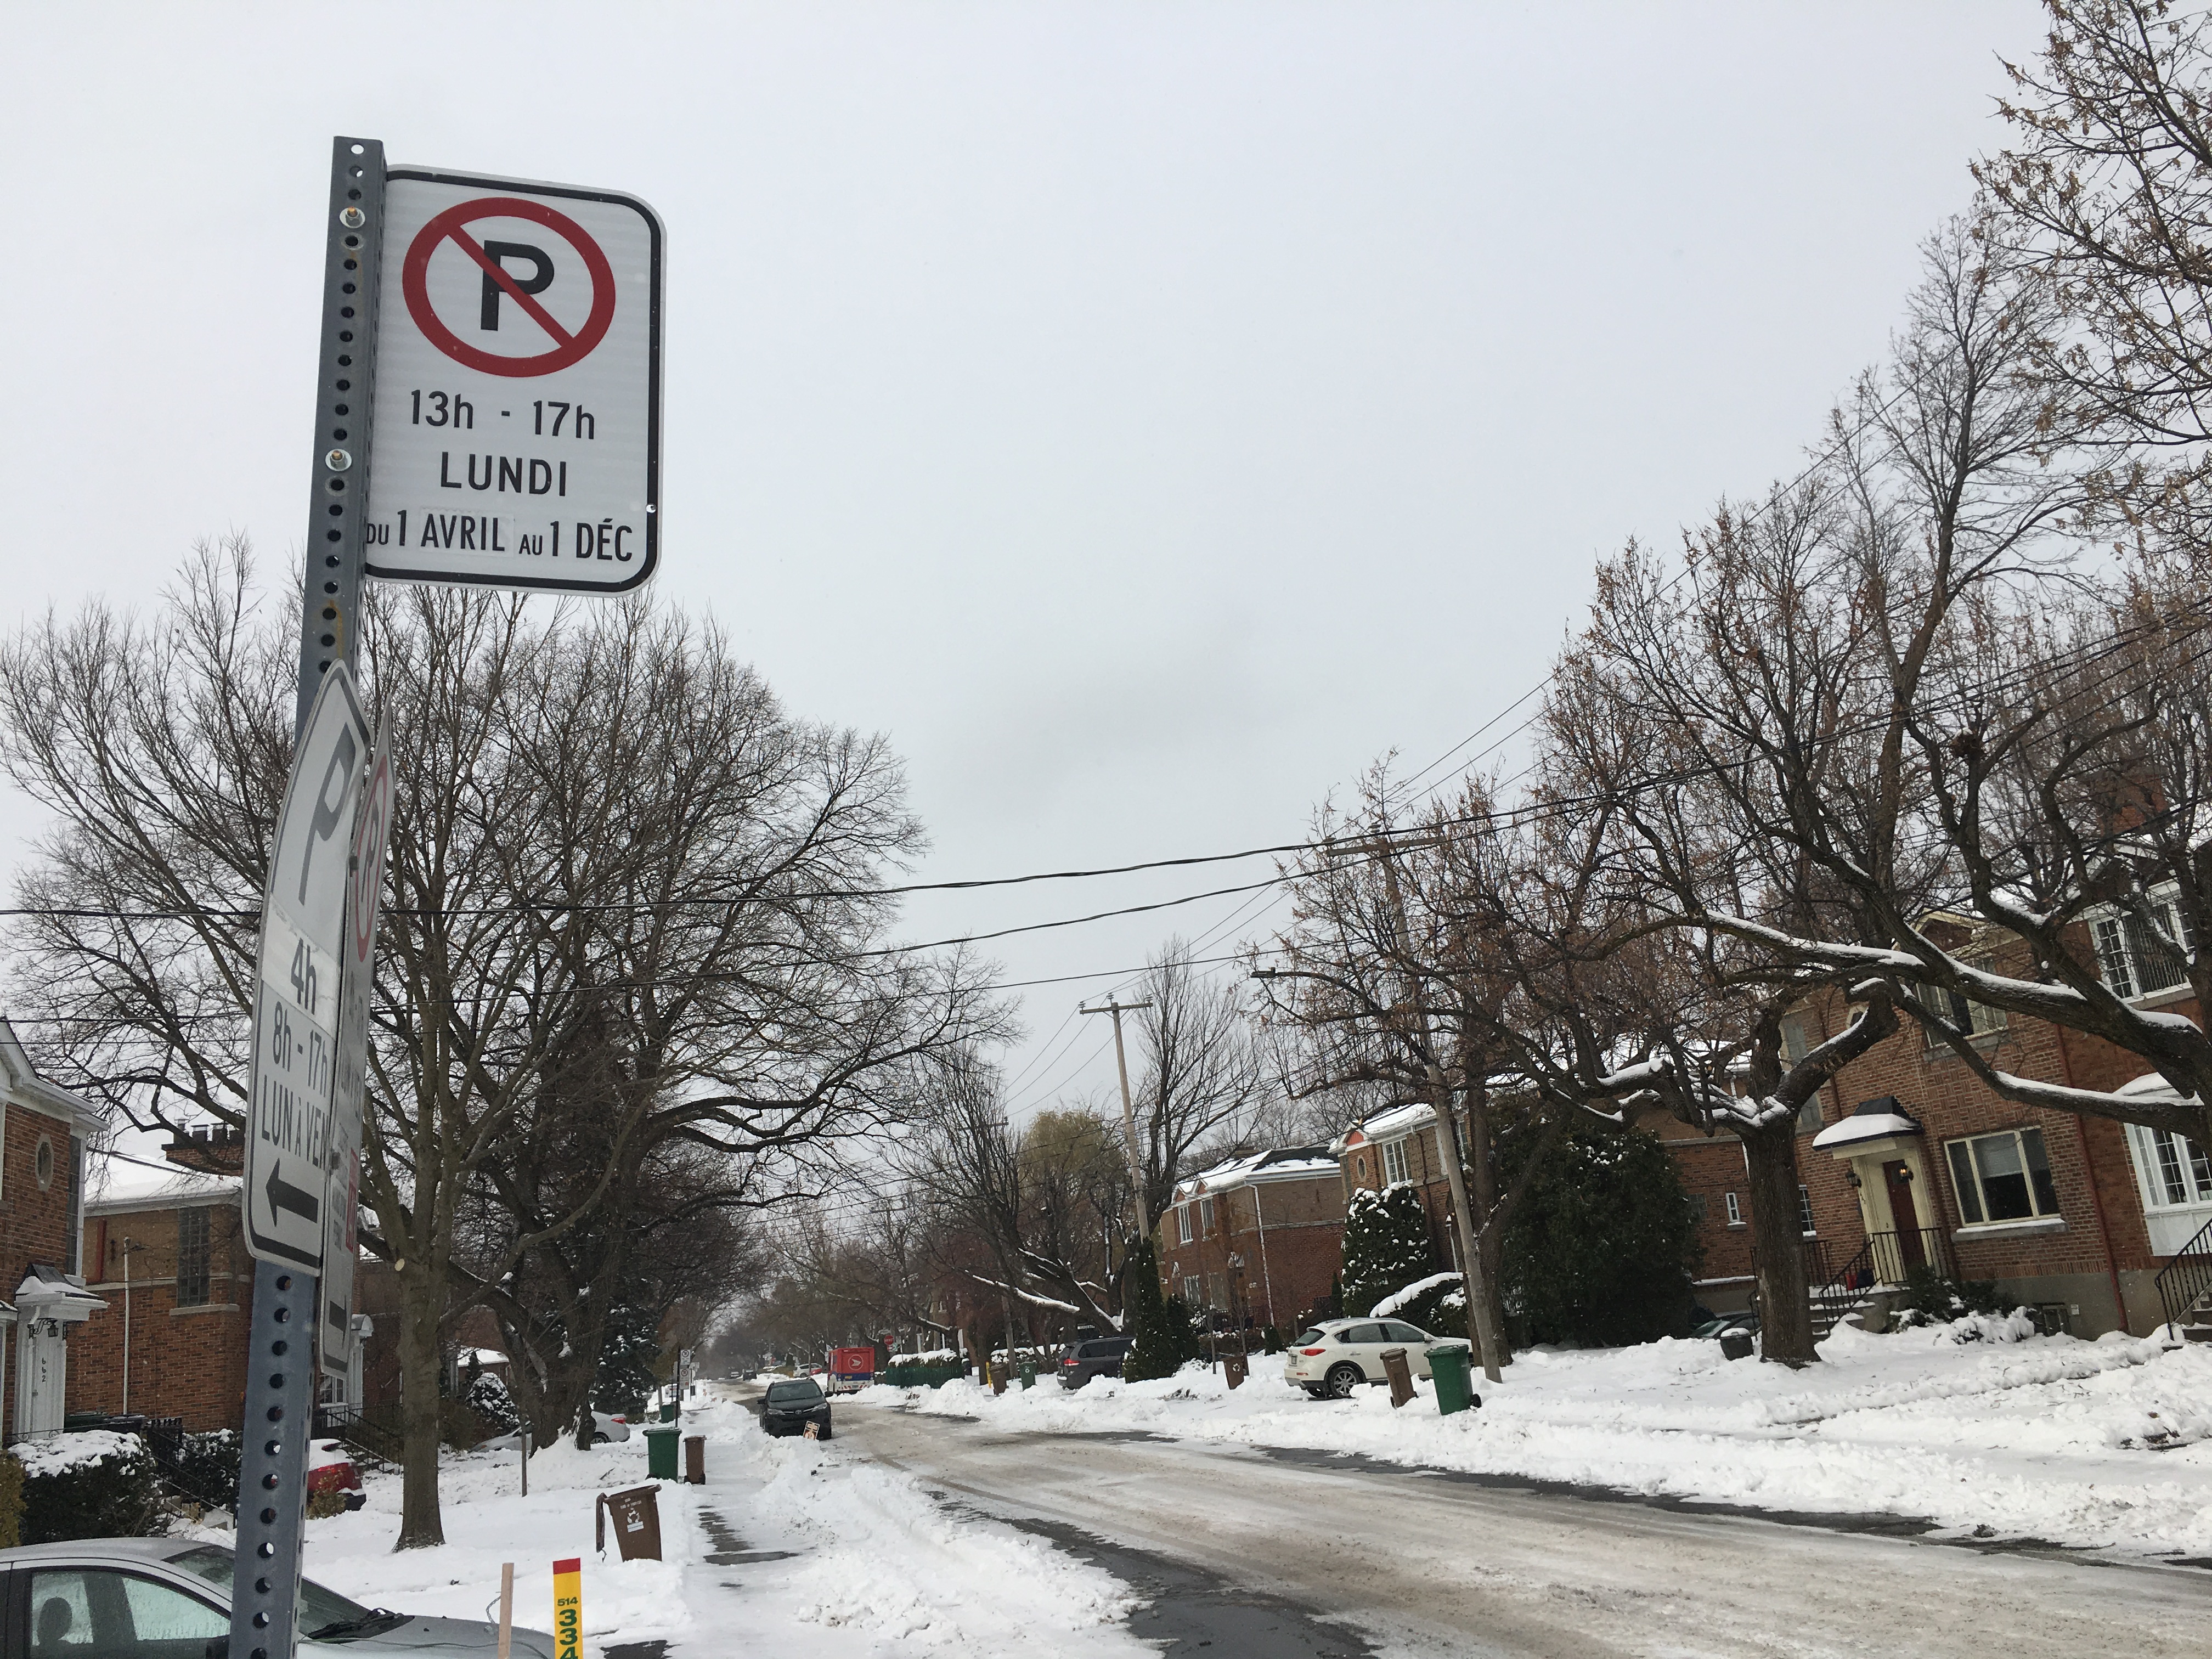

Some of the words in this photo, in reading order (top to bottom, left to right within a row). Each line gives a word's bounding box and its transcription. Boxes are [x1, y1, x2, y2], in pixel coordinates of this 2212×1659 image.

[481, 240, 555, 331] P
[411, 390, 473, 429] 13h
[533, 400, 595, 439] 17h
[441, 452, 567, 496] LUNDI
[366, 523, 389, 545] DU
[397, 510, 407, 546] 1
[420, 513, 505, 551] AVRIL
[519, 534, 543, 555] AU
[550, 521, 559, 557] 1
[576, 518, 633, 561] DÉC
[298, 721, 356, 906] P
[291, 938, 317, 1015] 4h
[273, 1001, 291, 1072] 8h
[308, 1029, 328, 1097] 17h
[262, 1074, 294, 1152] LUN
[307, 1102, 330, 1171] VEN
[557, 1597, 578, 1606] 514
